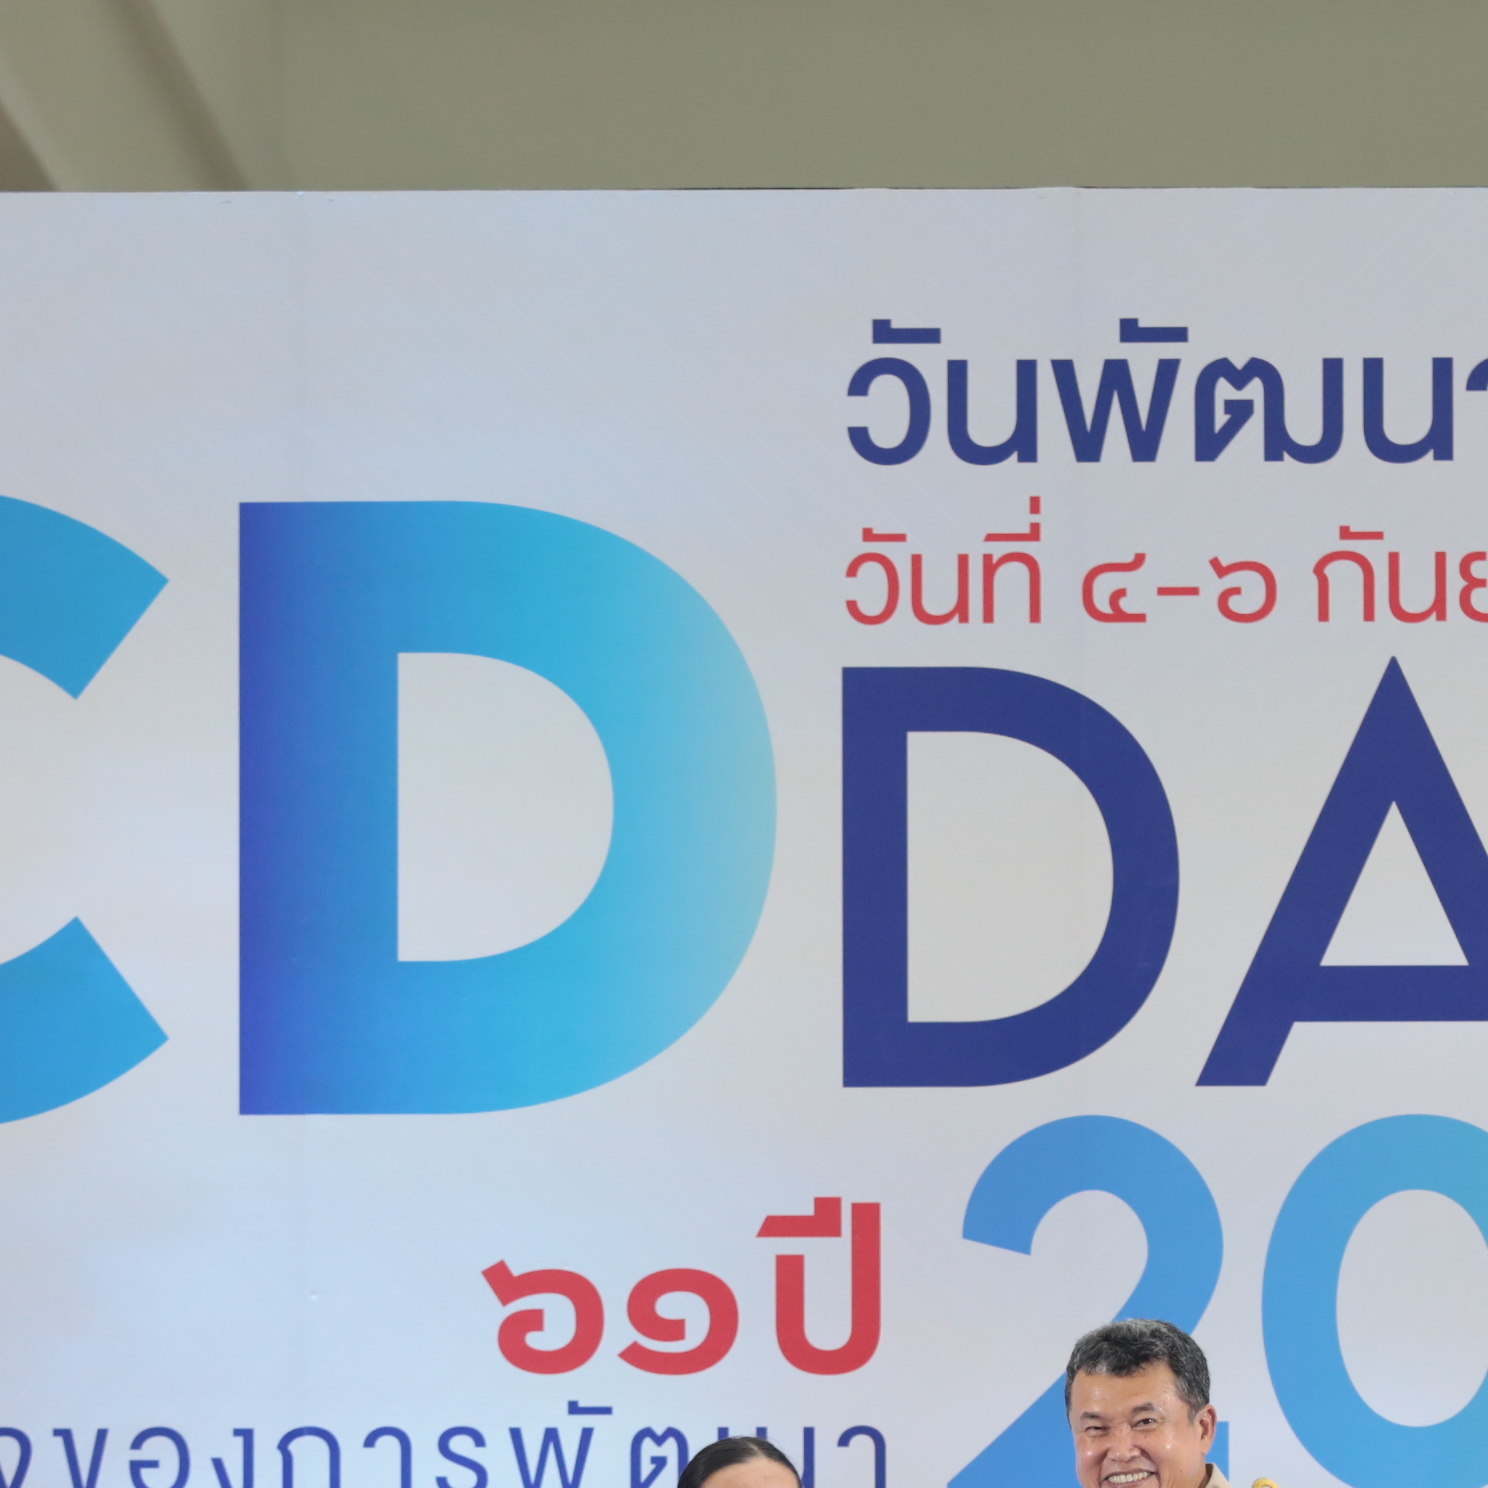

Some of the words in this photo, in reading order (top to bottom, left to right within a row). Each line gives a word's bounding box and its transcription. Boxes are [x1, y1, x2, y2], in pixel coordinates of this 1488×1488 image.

[846, 496, 1043, 626] วันที่
[1082, 552, 1278, 624] ๔-๖
